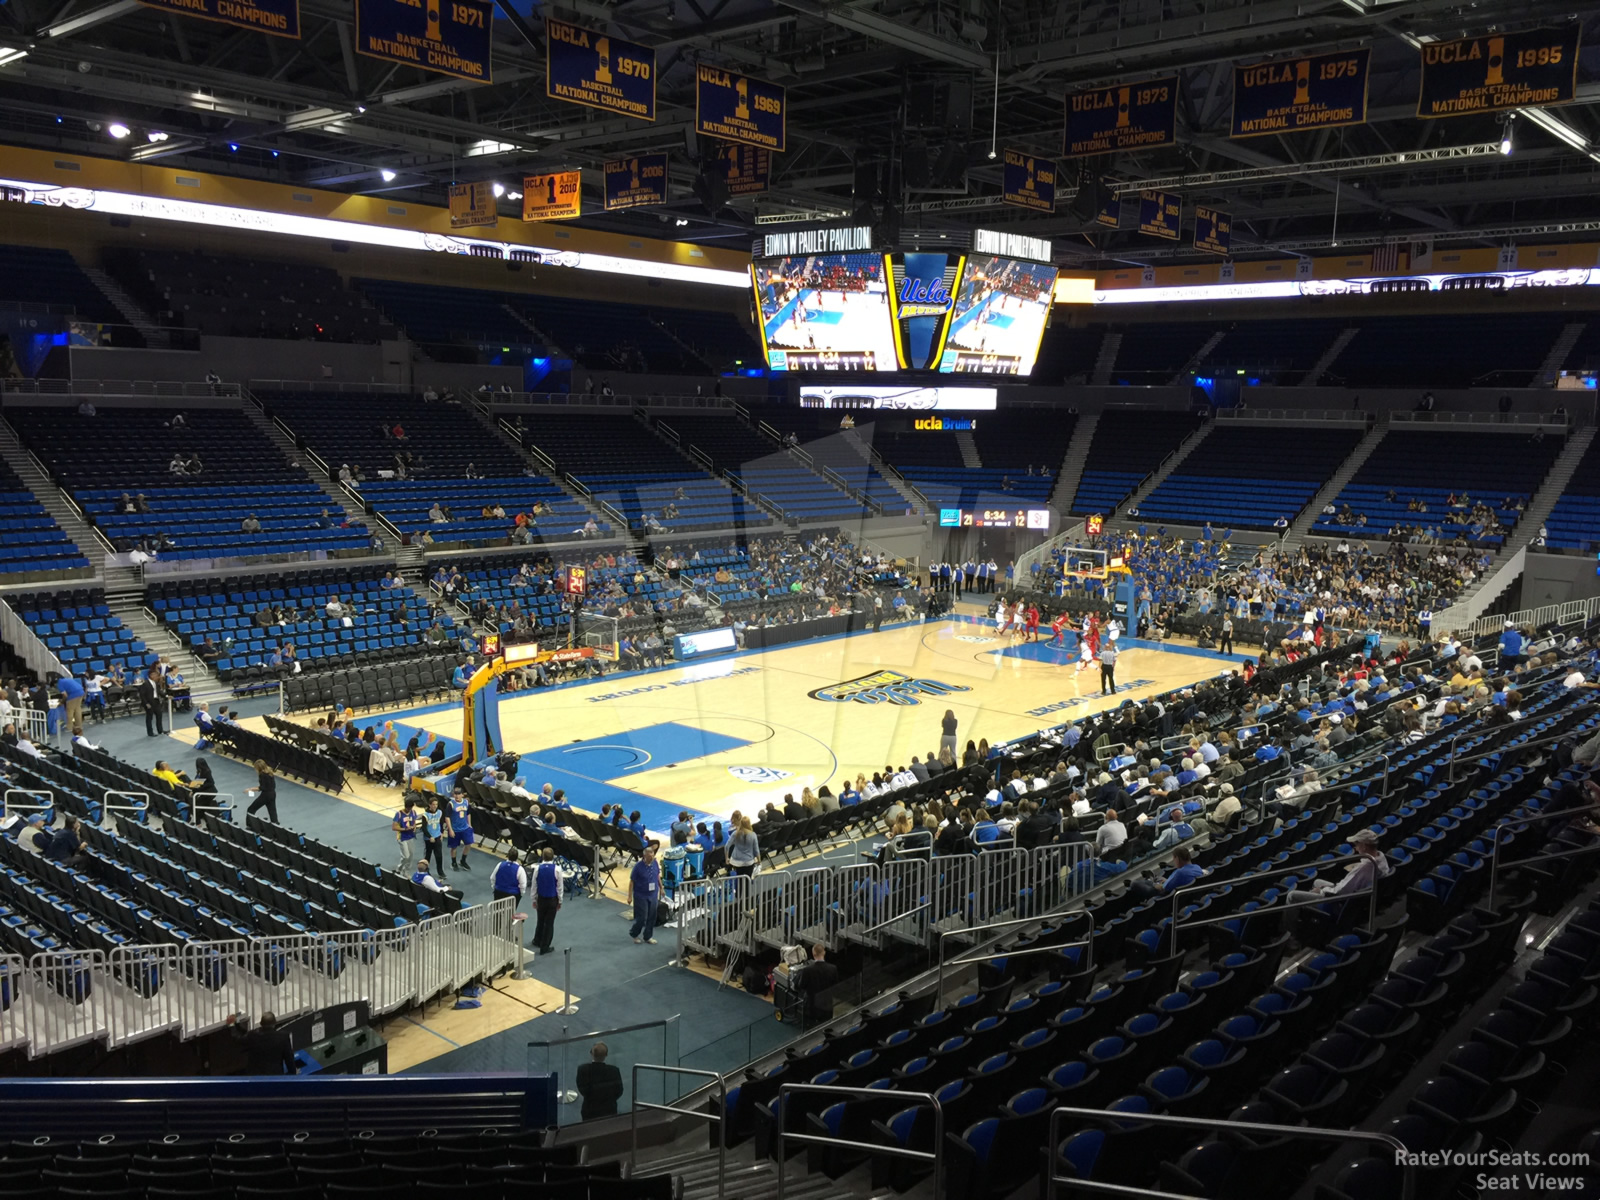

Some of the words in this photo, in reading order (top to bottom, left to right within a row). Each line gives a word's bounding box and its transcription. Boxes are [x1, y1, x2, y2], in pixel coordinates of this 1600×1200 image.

[217, 1, 288, 30] CHAMPIONS
[452, 4, 484, 28] 1971
[396, 33, 458, 56] BASKETBALL
[551, 23, 590, 48] UCLA
[618, 57, 649, 79] 1970
[369, 37, 420, 60] NATIONAL
[427, 51, 483, 76] CHAMPIONS
[1426, 41, 1482, 65] UCLA
[1517, 45, 1563, 68] 1995
[1244, 64, 1293, 88] UCLA
[1320, 60, 1358, 80] 1975
[581, 80, 623, 97] BASKETBALL
[700, 67, 731, 88] UCLA
[754, 94, 780, 115] 1969
[1459, 82, 1530, 99] BASKETBALL
[555, 84, 599, 103] NATIONAL
[601, 95, 648, 114] CHAMPIONS
[1072, 91, 1114, 112] UCLA
[1137, 87, 1169, 106] 1973
[1432, 97, 1488, 113] NATIONAL
[1493, 87, 1559, 106] CHAMPIONS
[1267, 103, 1327, 117] BASKETBALL
[724, 116, 758, 131] BASKETBALL
[1241, 116, 1288, 132] NATIONAL
[1296, 107, 1353, 125] CHAMPIONS
[703, 121, 738, 136] NATIONAL
[739, 129, 777, 146] CHAMPIONS
[1093, 126, 1144, 139] BASKETBALL
[1071, 139, 1111, 153] NATIONAL
[1117, 131, 1166, 146] CHAMPIONS
[1005, 151, 1025, 167] UCLA
[606, 161, 627, 174] UCLA
[642, 166, 664, 178] 2006
[450, 186, 467, 197] UCLA
[525, 178, 545, 189] UCLA
[559, 183, 577, 194] 2010
[1141, 190, 1157, 202] UCLA
[527, 211, 550, 219] NATIONAL
[550, 209, 577, 217] CHAMPIONS
[765, 233, 788, 256] EDWIN
[789, 232, 797, 255] W
[798, 229, 828, 254] PAULEY
[829, 226, 871, 252] PAVILION
[963, 514, 973, 526] 21
[984, 510, 1006, 520] 6:34
[1015, 515, 1025, 527] 12
[1088, 524, 1100, 533] 24
[570, 577, 583, 591] 24
[485, 644, 496, 653] 24
[585, 684, 668, 703] COURT
